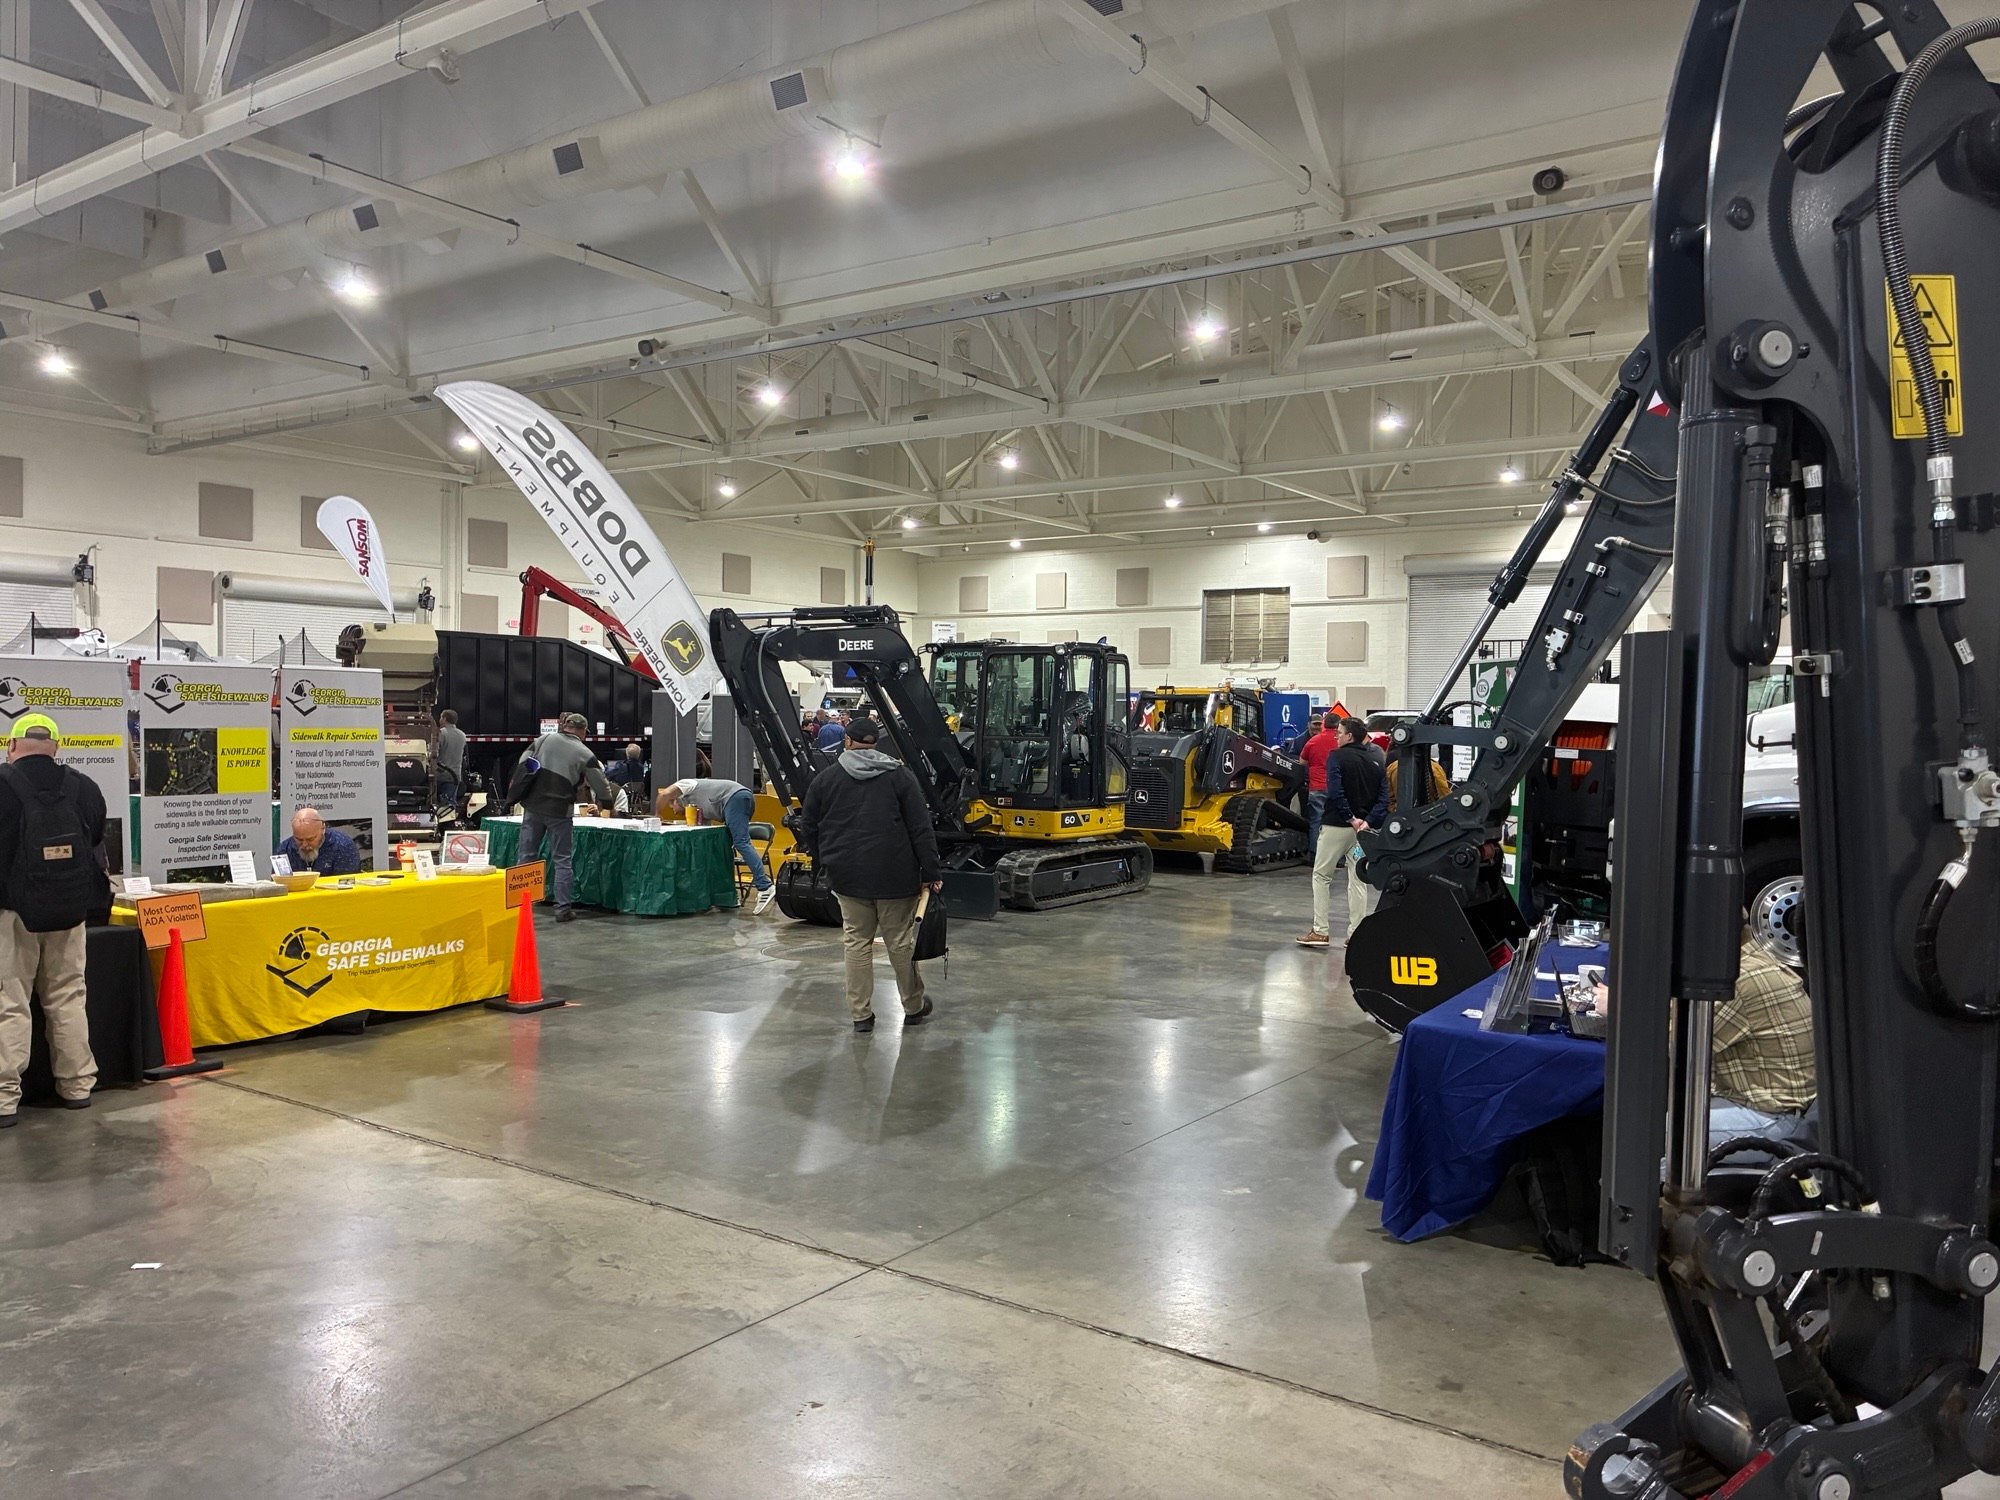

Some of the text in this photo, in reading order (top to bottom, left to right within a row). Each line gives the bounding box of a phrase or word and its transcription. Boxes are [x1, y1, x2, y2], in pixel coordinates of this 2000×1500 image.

[356, 518, 370, 577] SANSOM
[838, 638, 874, 651] DEERE
[17, 687, 71, 697] GEORGIA
[174, 683, 222, 693] GEORGIA
[309, 688, 346, 697] GEORGIA
[25, 696, 123, 707] SAFE SIDEWALKS
[180, 692, 269, 702] SAFE SIDEWALKS
[313, 696, 381, 706] SAFE SIDEWALKS
[292, 732, 378, 742] Sidewalk Repair Services
[61, 737, 115, 748] Management
[220, 747, 266, 756] KNOWLEDGE
[296, 750, 317, 758] Removal
[325, 749, 333, 758] Trip
[335, 749, 344, 757] and
[345, 749, 354, 757] Fall
[356, 749, 374, 757] Hazards
[86, 757, 115, 765] process
[227, 759, 260, 768] IS POWER
[322, 760, 341, 768] Hazards
[366, 759, 380, 768] Every
[1276, 755, 1293, 770] DEERE
[295, 771, 306, 779] Year
[296, 782, 313, 790] Unique
[315, 782, 341, 790] Proprietary
[296, 793, 307, 801] Only
[164, 800, 191, 809] Knowing
[192, 799, 201, 807] the
[203, 798, 231, 806] condition
[239, 799, 252, 808] your
[166, 810, 196, 818] sidewalks
[229, 808, 241, 817] step
[154, 821, 179, 830] creating
[187, 820, 200, 828] safe
[202, 818, 228, 827] walkable
[229, 817, 261, 826] community
[1064, 816, 1075, 825] 60
[168, 832, 246, 844] Georgia Safe Sidewalk's
[177, 843, 240, 854] Inspection Services
[174, 853, 210, 863] unmatched
[219, 851, 228, 859] the
[524, 870, 534, 878] cost
[509, 882, 529, 891] Remove
[143, 903, 197, 916] Most Common
[145, 913, 199, 927] ADA Violation
[316, 937, 392, 957] GEORGIA
[327, 939, 465, 971] SAFE SIDEWALKS
[360, 968, 380, 976] Hazard
[381, 964, 406, 972] Removal
[407, 959, 436, 968] Specialists
[1391, 956, 1438, 986] WB
